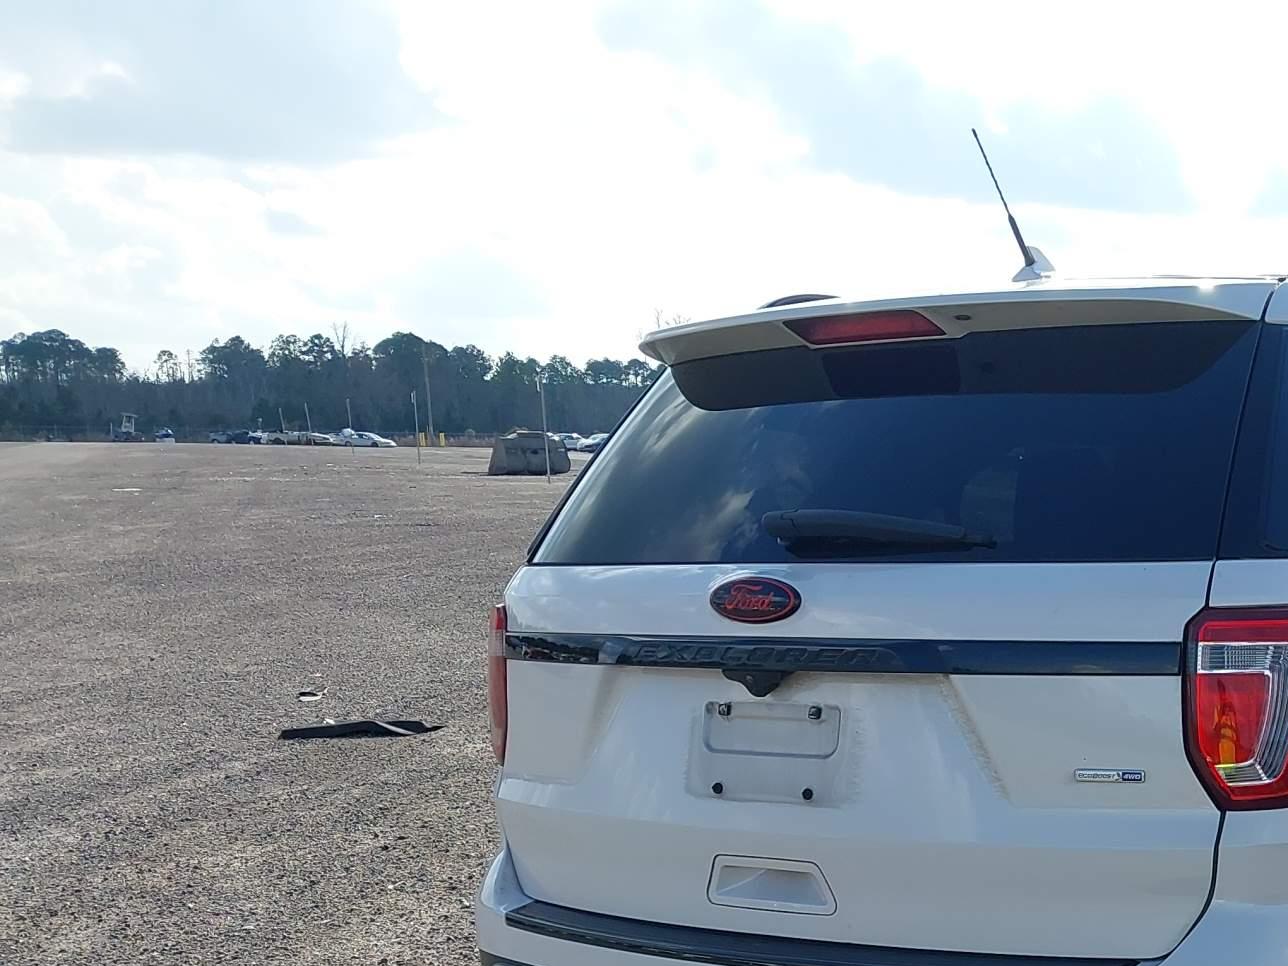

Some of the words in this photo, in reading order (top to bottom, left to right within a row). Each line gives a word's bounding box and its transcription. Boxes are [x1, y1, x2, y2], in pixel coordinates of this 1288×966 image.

[725, 583, 775, 610] Ford
[633, 643, 881, 665] EXPLORER
[1123, 772, 1141, 780] 4WD
